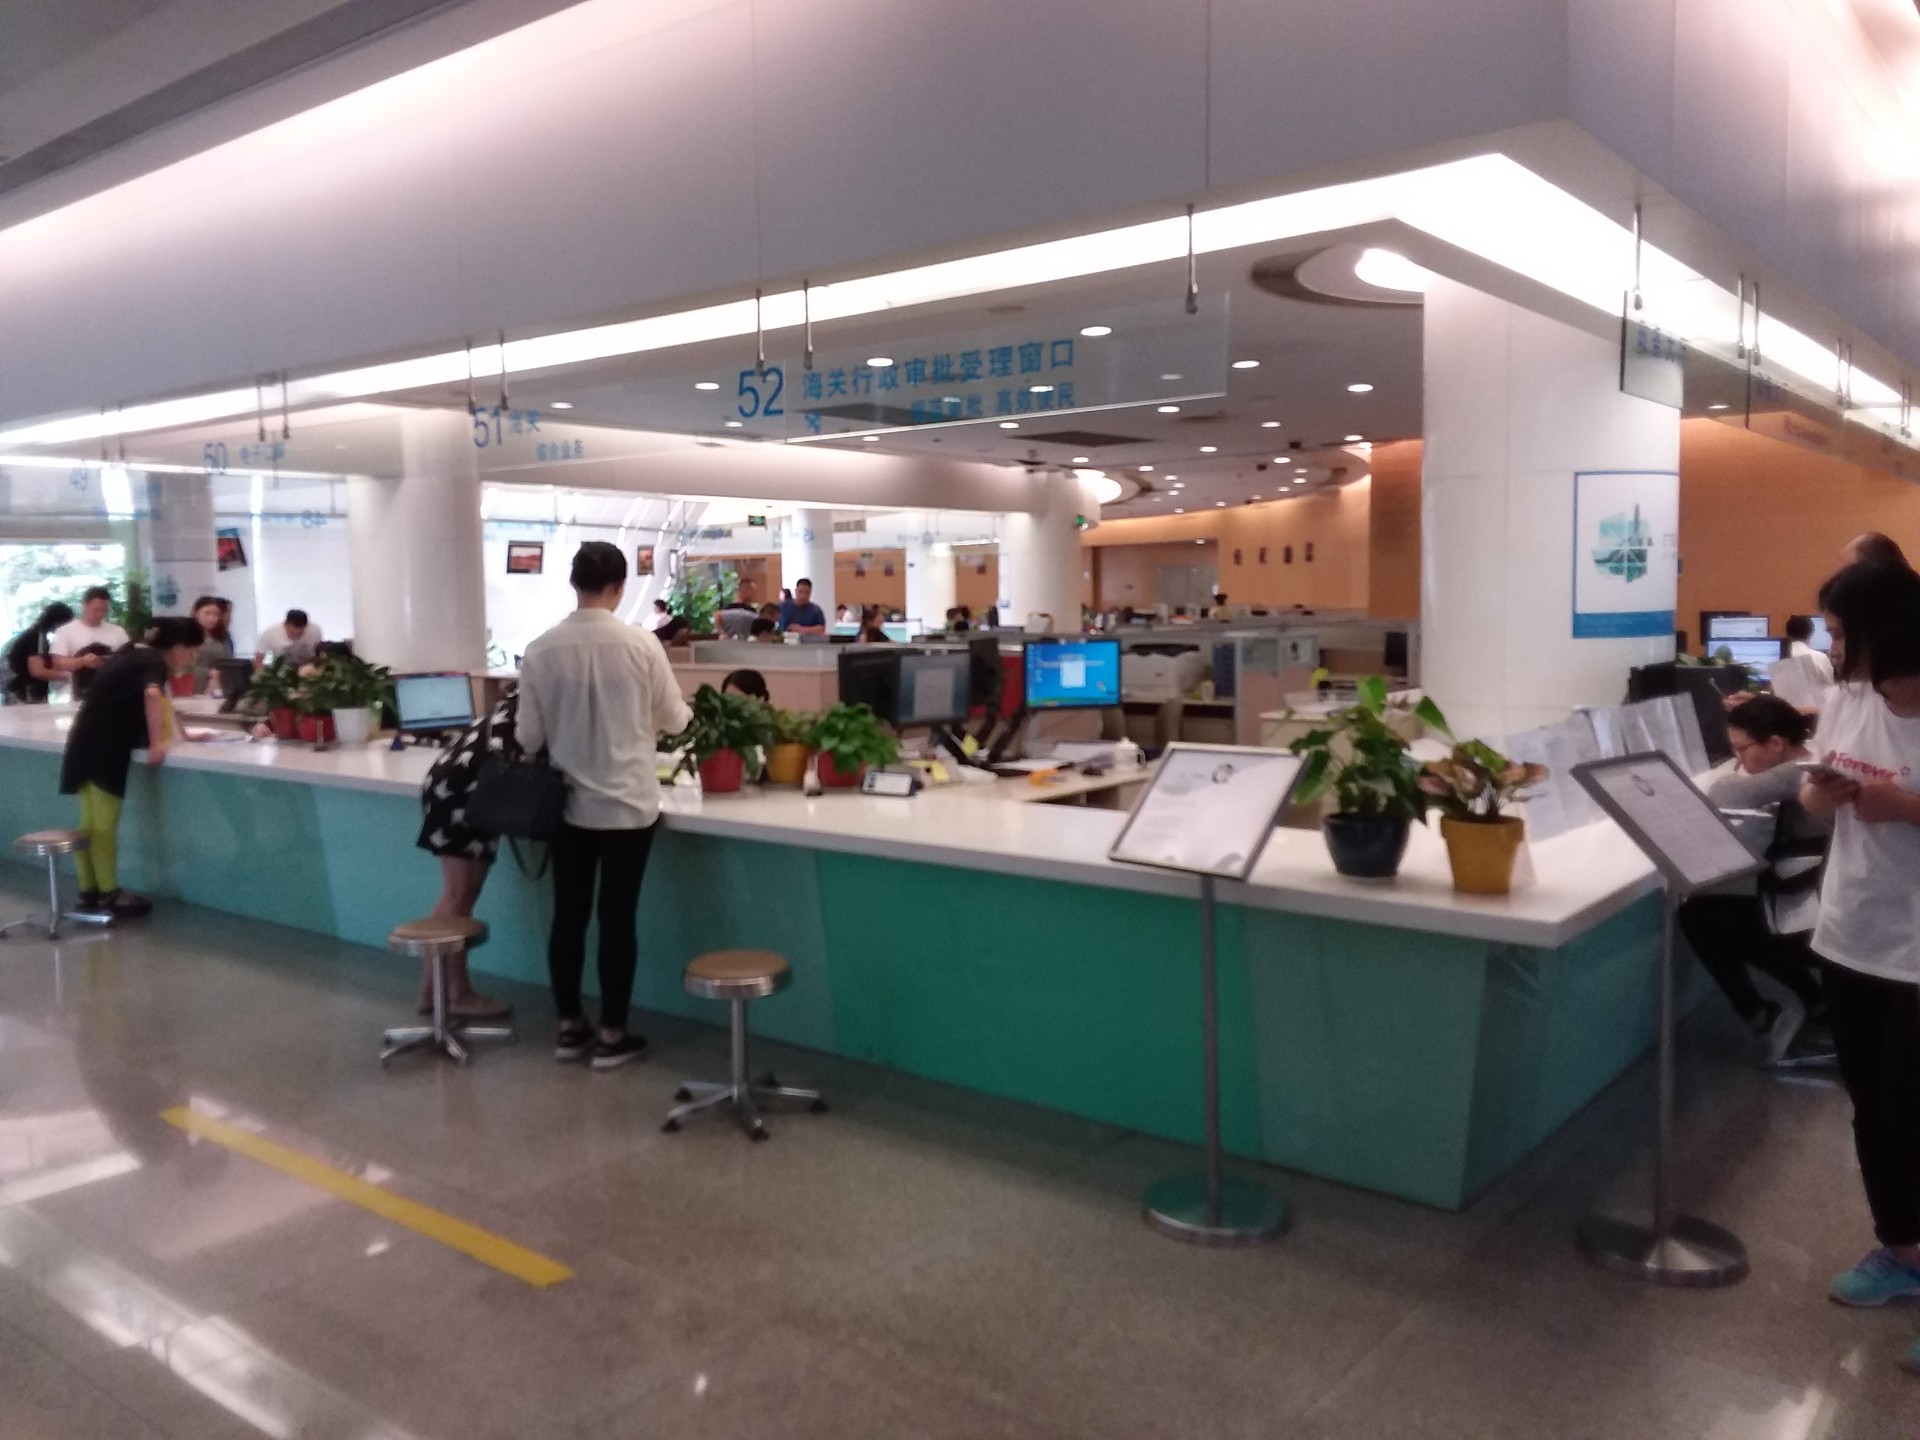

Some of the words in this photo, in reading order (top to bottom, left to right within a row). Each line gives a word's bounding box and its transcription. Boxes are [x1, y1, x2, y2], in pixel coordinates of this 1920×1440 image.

[738, 366, 784, 419] 52
[802, 338, 1075, 402] 海关行政审批受理窗口
[473, 404, 503, 449] 51
[203, 442, 228, 475] 50
